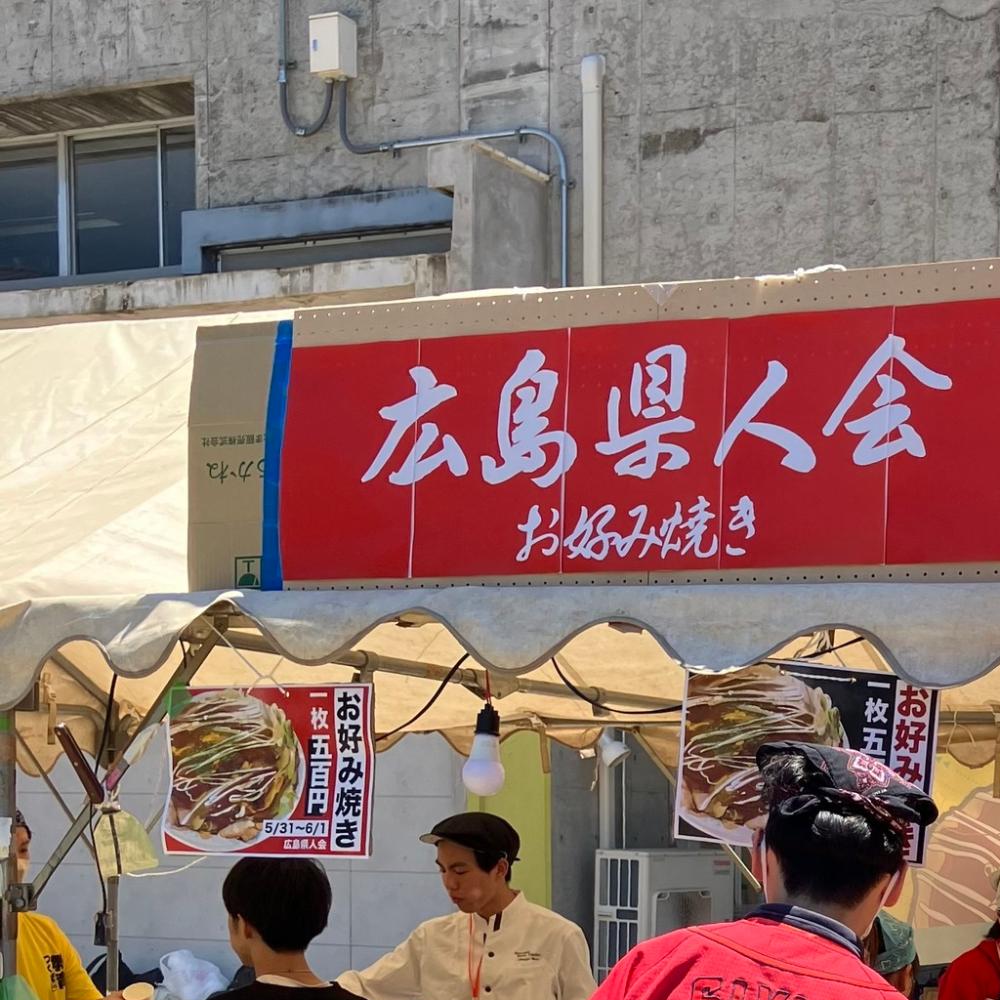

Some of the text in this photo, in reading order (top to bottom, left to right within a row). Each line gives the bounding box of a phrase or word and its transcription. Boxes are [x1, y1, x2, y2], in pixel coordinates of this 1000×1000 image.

[361, 334, 952, 488] 広島県人会
[514, 495, 756, 562] お好み焼き
[305, 691, 333, 816] 一枚五百円
[334, 691, 364, 849] お好み焼き
[283, 839, 327, 850] 広島県人会
